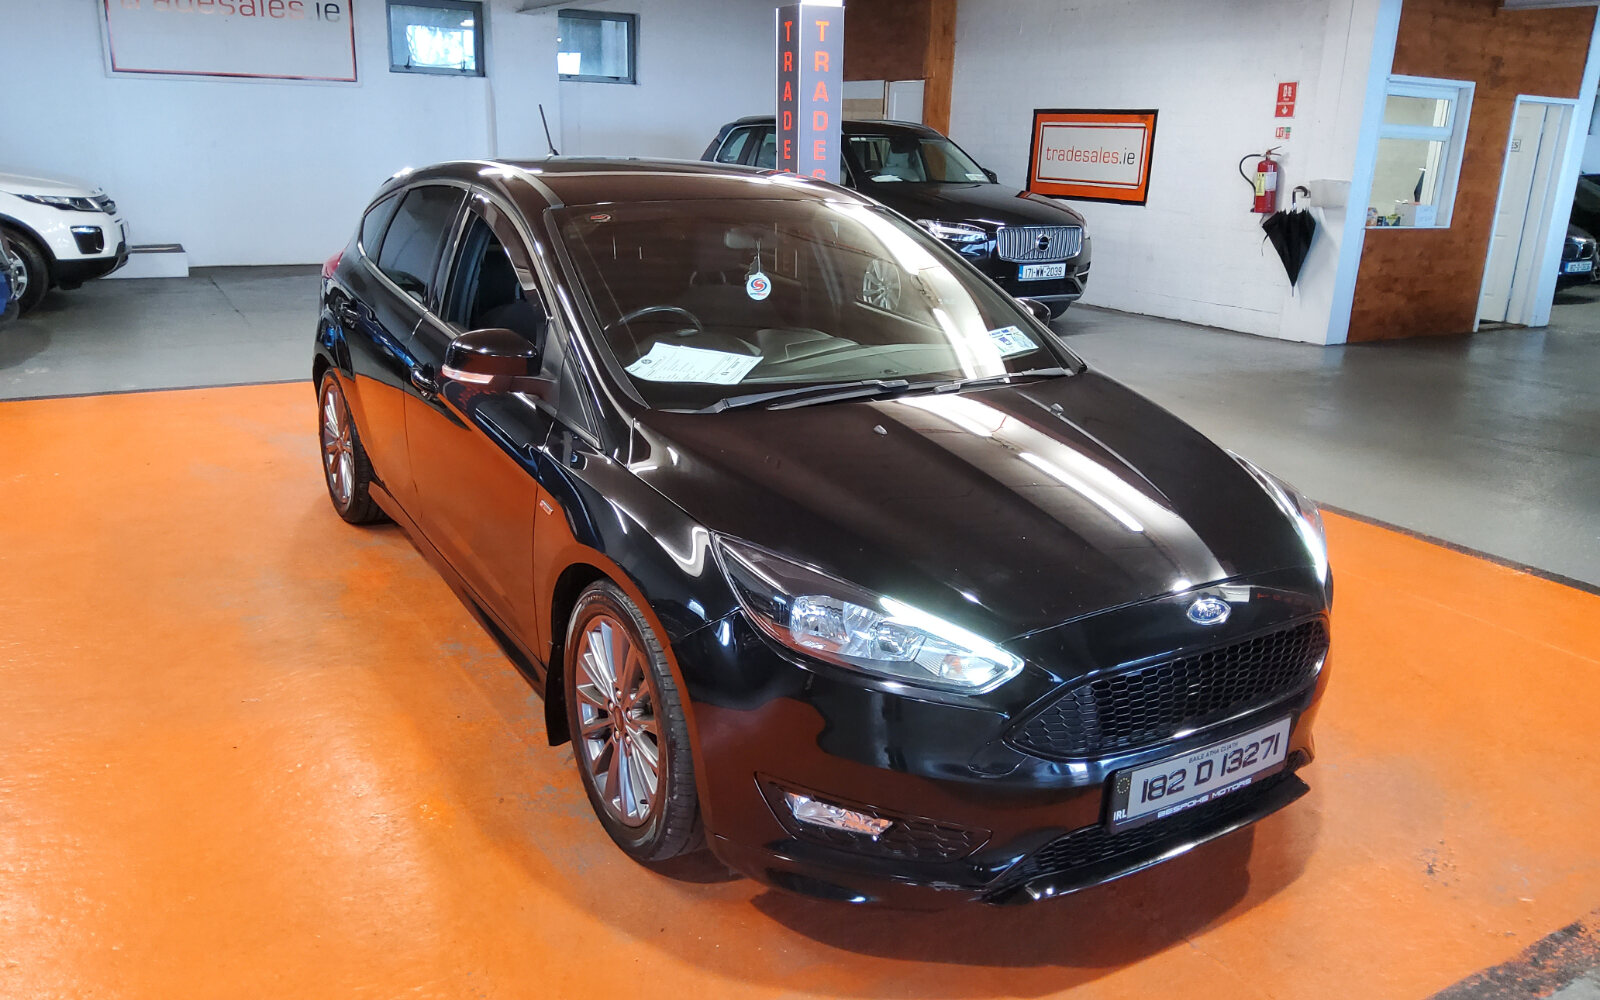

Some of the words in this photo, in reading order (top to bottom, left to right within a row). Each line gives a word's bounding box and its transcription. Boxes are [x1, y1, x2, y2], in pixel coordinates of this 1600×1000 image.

[783, 20, 793, 174] TRADE
[1046, 145, 1136, 165] tradesales.ie
[1140, 768, 1187, 804] 182
[1194, 762, 1213, 786] D
[1220, 732, 1281, 777] 13271
[1211, 777, 1253, 799] MOTORS
[1112, 808, 1127, 822] IRL
